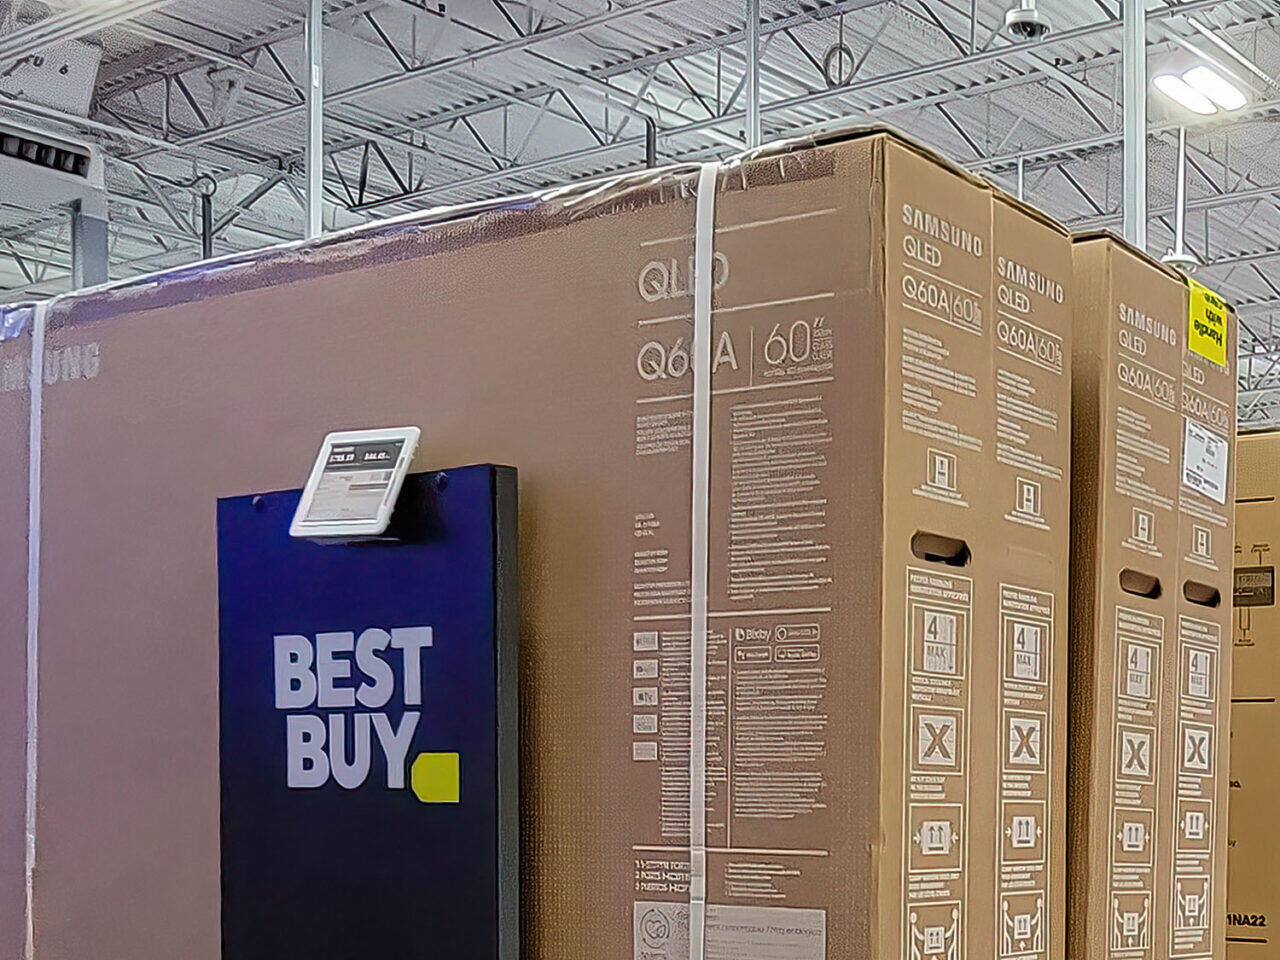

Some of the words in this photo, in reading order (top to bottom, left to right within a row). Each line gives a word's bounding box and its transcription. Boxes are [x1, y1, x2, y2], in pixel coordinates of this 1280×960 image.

[902, 204, 982, 257] SAMSUNG
[903, 235, 942, 267] QLED
[638, 251, 729, 302] QLD
[997, 256, 1064, 303] SAMSUNG
[902, 275, 950, 313] Q60A
[998, 285, 1030, 314] QLED
[1119, 303, 1177, 346] SAMSUNG
[1193, 319, 1223, 347] Handle
[1205, 308, 1223, 326] with
[637, 320, 738, 381] Q6A
[997, 320, 1035, 356] Q60A
[1119, 329, 1147, 357] QLED
[1118, 363, 1153, 397] Q60A
[927, 614, 938, 641] 4
[1016, 627, 1025, 650] 4
[273, 626, 433, 710] BEST
[1130, 647, 1138, 669] 4
[1191, 653, 1199, 671] 4
[286, 711, 420, 790] BUY
